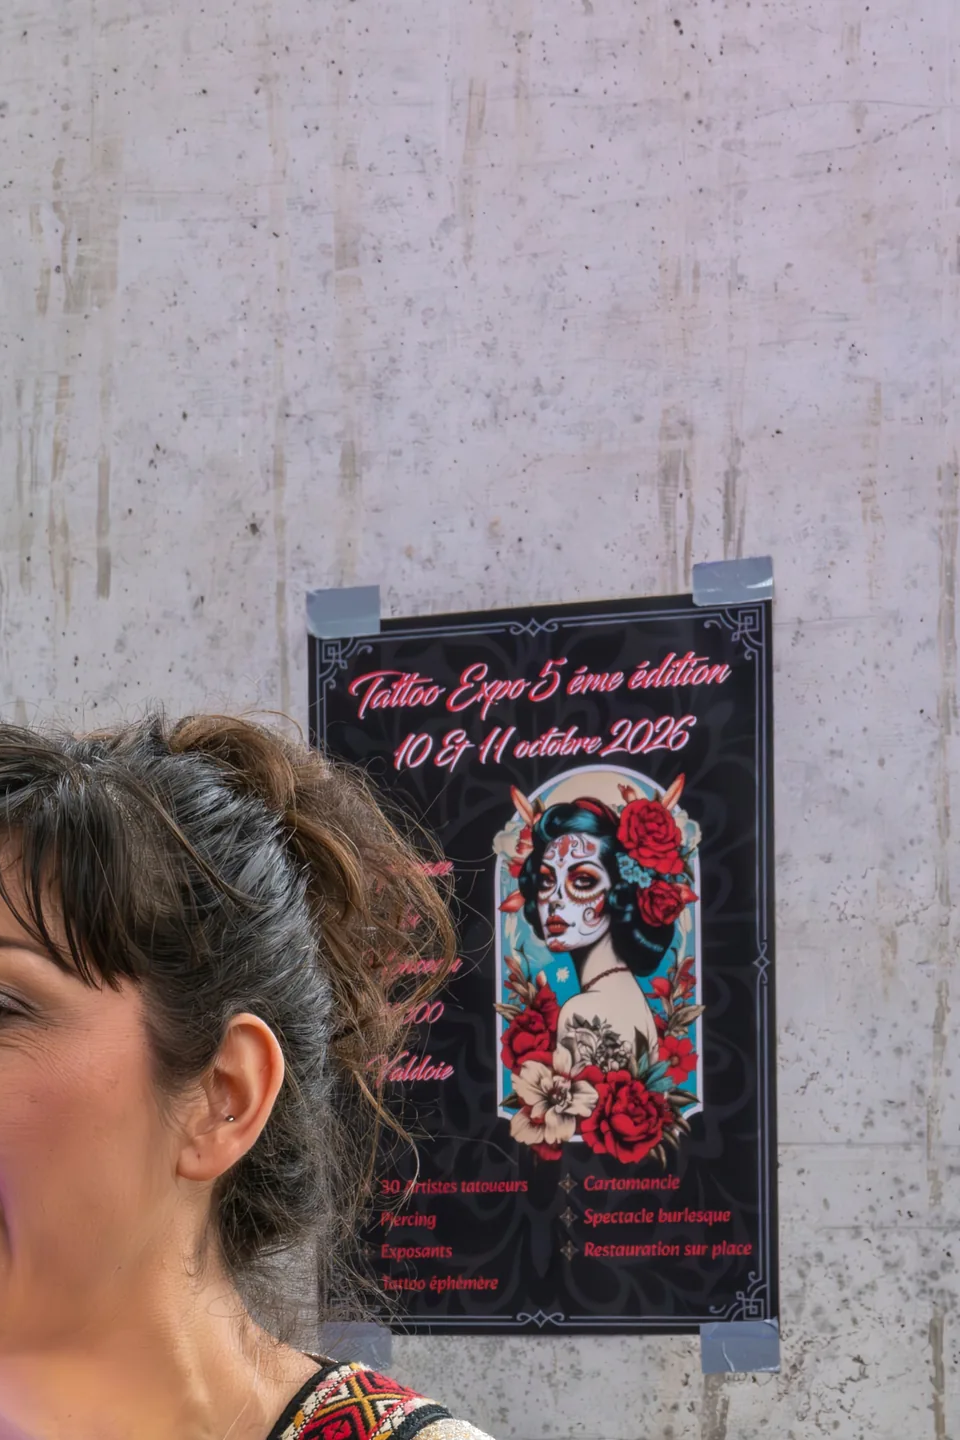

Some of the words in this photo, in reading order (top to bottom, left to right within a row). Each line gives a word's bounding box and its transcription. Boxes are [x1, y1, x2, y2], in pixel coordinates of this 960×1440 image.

[348, 670, 446, 720] Tattoo
[446, 662, 531, 721] Expo
[528, 657, 568, 702] 5
[628, 651, 732, 690] édition
[394, 733, 433, 771] 10
[434, 728, 475, 773] &
[479, 726, 516, 765] 11
[513, 726, 603, 759] octobre
[598, 715, 697, 757] 2026
[461, 1180, 529, 1193] tatoueurs
[583, 1174, 681, 1192] Cartomancie
[380, 1211, 437, 1230] Piercing
[583, 1208, 654, 1228] Spectacle
[658, 1207, 732, 1227] burlesque
[380, 1243, 453, 1262] Exposants
[583, 1241, 680, 1258] Restauration
[684, 1244, 709, 1256] sur
[712, 1240, 753, 1260] place
[382, 1275, 426, 1291] Tattoo
